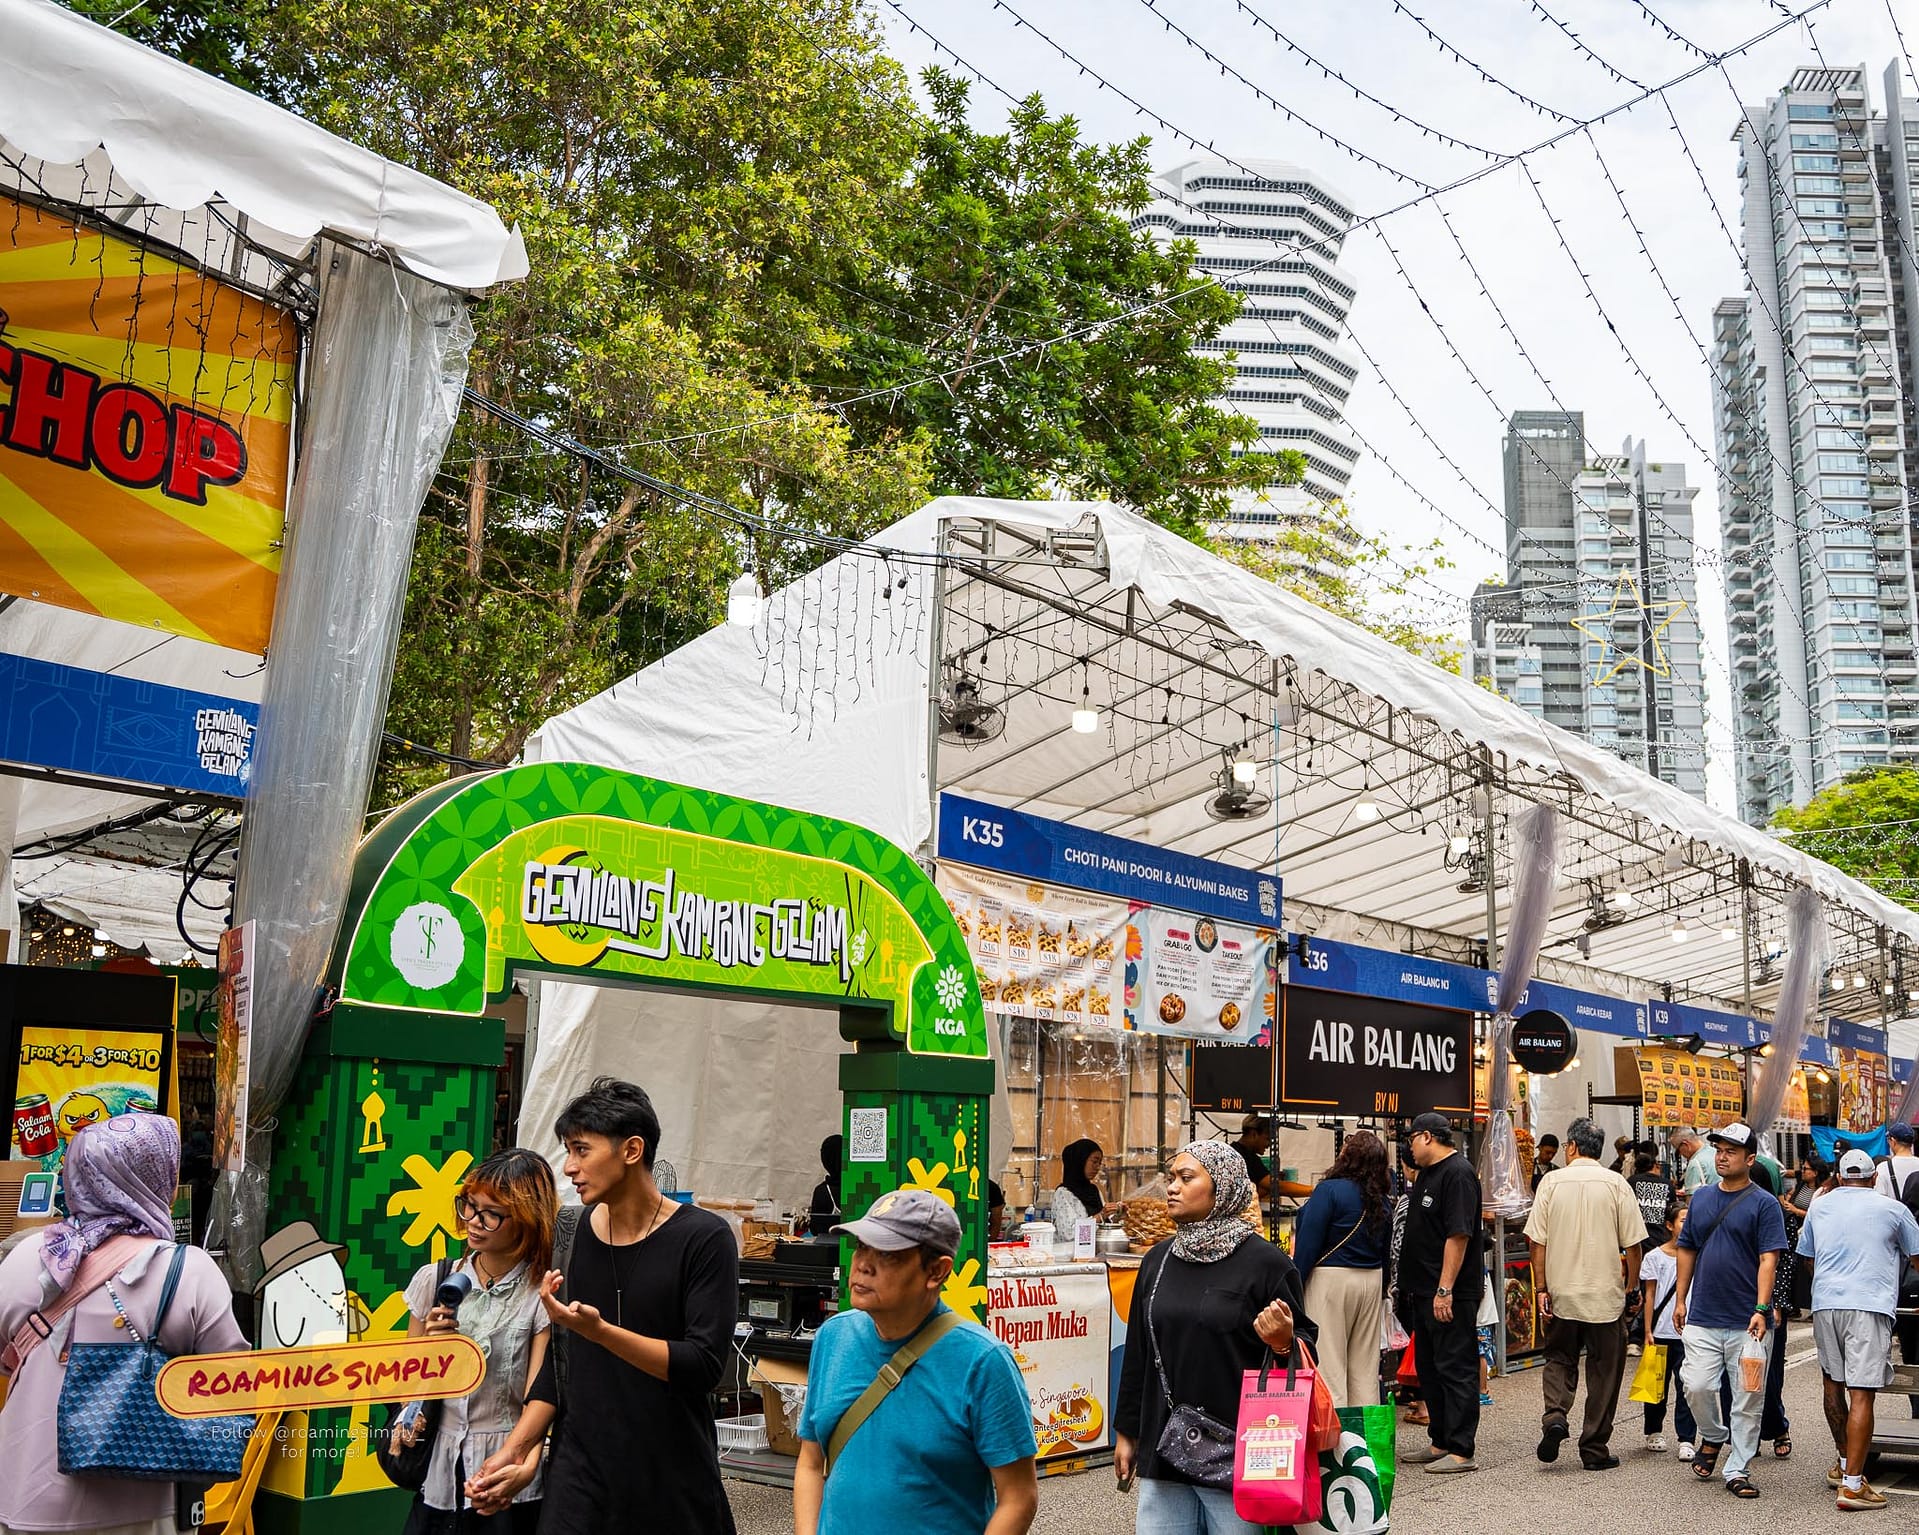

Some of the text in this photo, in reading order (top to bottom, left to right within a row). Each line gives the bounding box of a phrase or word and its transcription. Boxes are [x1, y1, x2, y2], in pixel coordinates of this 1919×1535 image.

[0, 340, 248, 506] HOP
[195, 707, 257, 739] GEMILANG
[196, 730, 251, 760] KAMPONG
[961, 815, 1004, 848] K35
[1064, 847, 1099, 869] CHOTI
[1102, 855, 1128, 876] PANI
[1130, 861, 1163, 883] POORI
[1165, 871, 1172, 884] &
[1174, 872, 1217, 896] ALYUMNI
[1219, 882, 1249, 902] BAKES
[522, 860, 850, 982] GEMILANG KAMPONG GELAM
[1401, 972, 1413, 985] AIR
[1414, 974, 1440, 989] BALANG
[1576, 1005, 1612, 1020] ARABICA KEBAB
[1655, 1009, 1669, 1024] K39
[934, 1017, 967, 1037] KGA
[1308, 1018, 1456, 1074] AIR BALANG
[1519, 1038, 1562, 1048] AIR BALANG
[55, 1044, 83, 1068] $4
[128, 1048, 161, 1071] $10
[1221, 1098, 1242, 1109] BY NJ
[1374, 1091, 1399, 1114] BY NJ
[17, 1113, 52, 1132] Salaam
[24, 1124, 52, 1142] Cola
[1638, 1198, 1667, 1208] NAISE
[1015, 1277, 1057, 1308] Kuda
[995, 1310, 1088, 1350] Depan Muka
[1060, 1414, 1087, 1427] freshest
[1042, 1434, 1059, 1445] kuda
